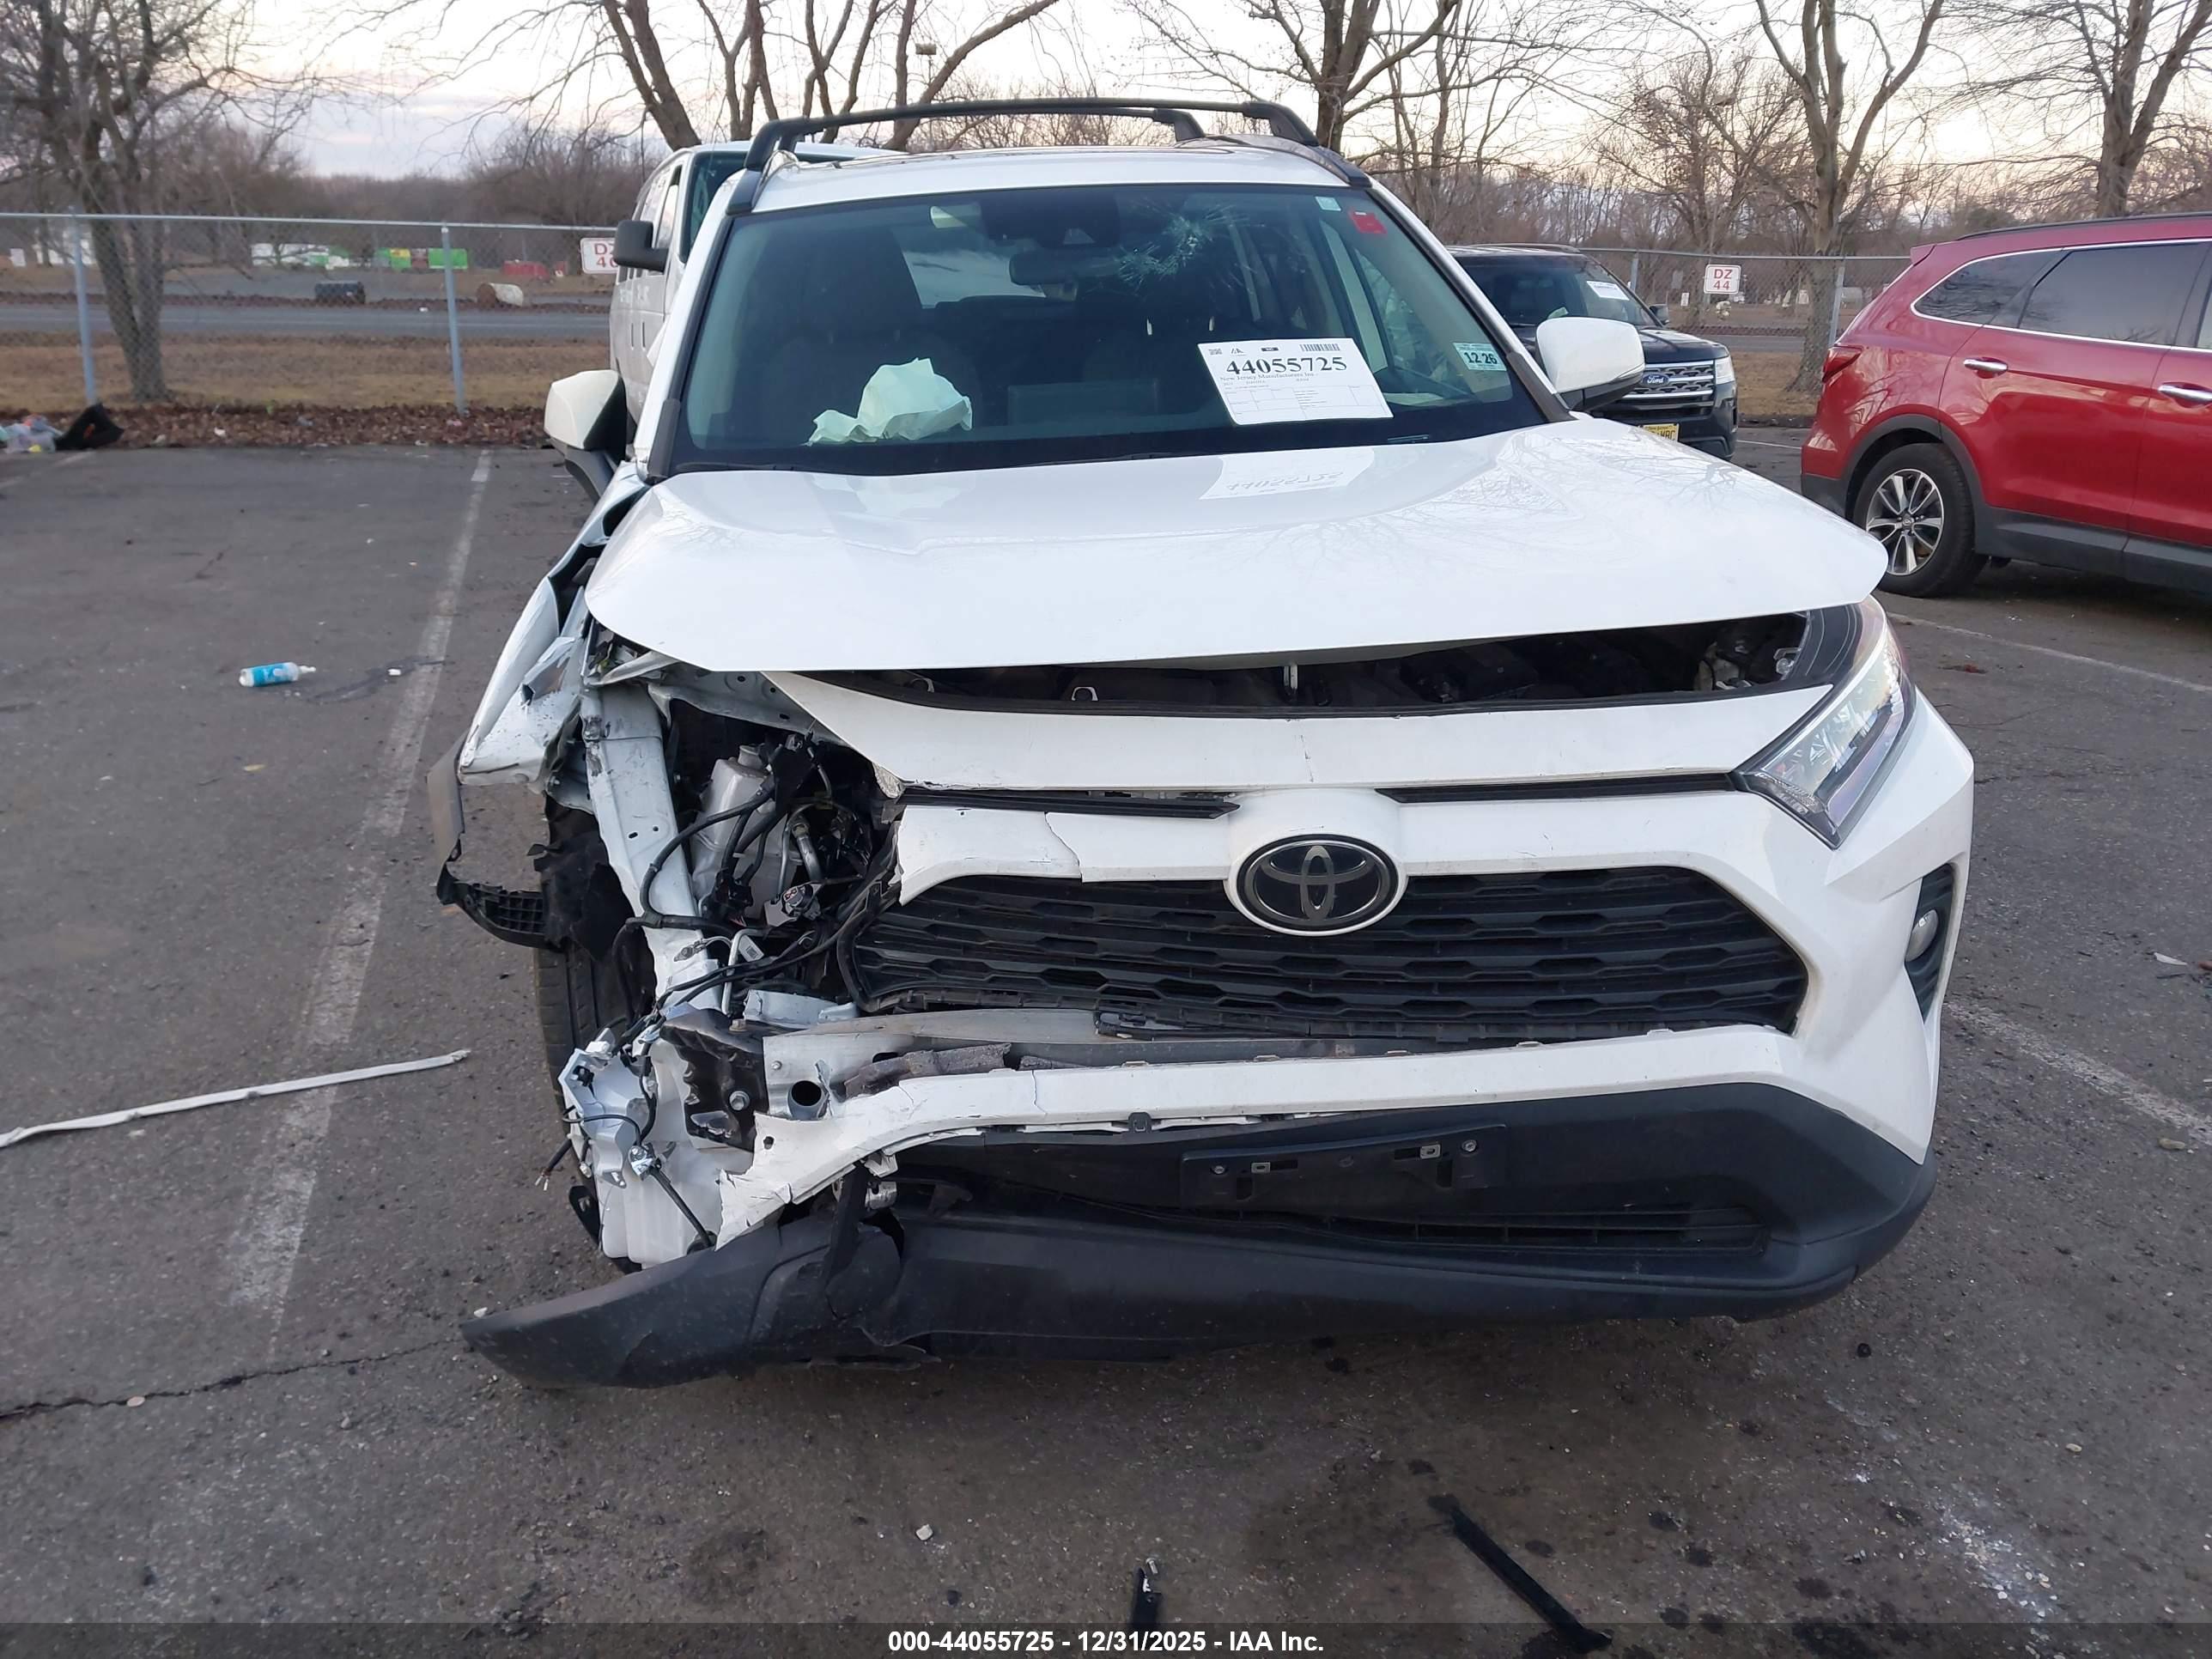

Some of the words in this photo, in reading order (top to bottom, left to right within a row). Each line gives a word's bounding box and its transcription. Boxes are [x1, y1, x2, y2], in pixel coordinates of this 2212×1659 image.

[1714, 269, 1733, 279] DZ
[1713, 281, 1730, 290] 44
[1463, 352, 1482, 364] 12
[1226, 356, 1347, 375] 44055725
[1647, 375, 1664, 384] Ford
